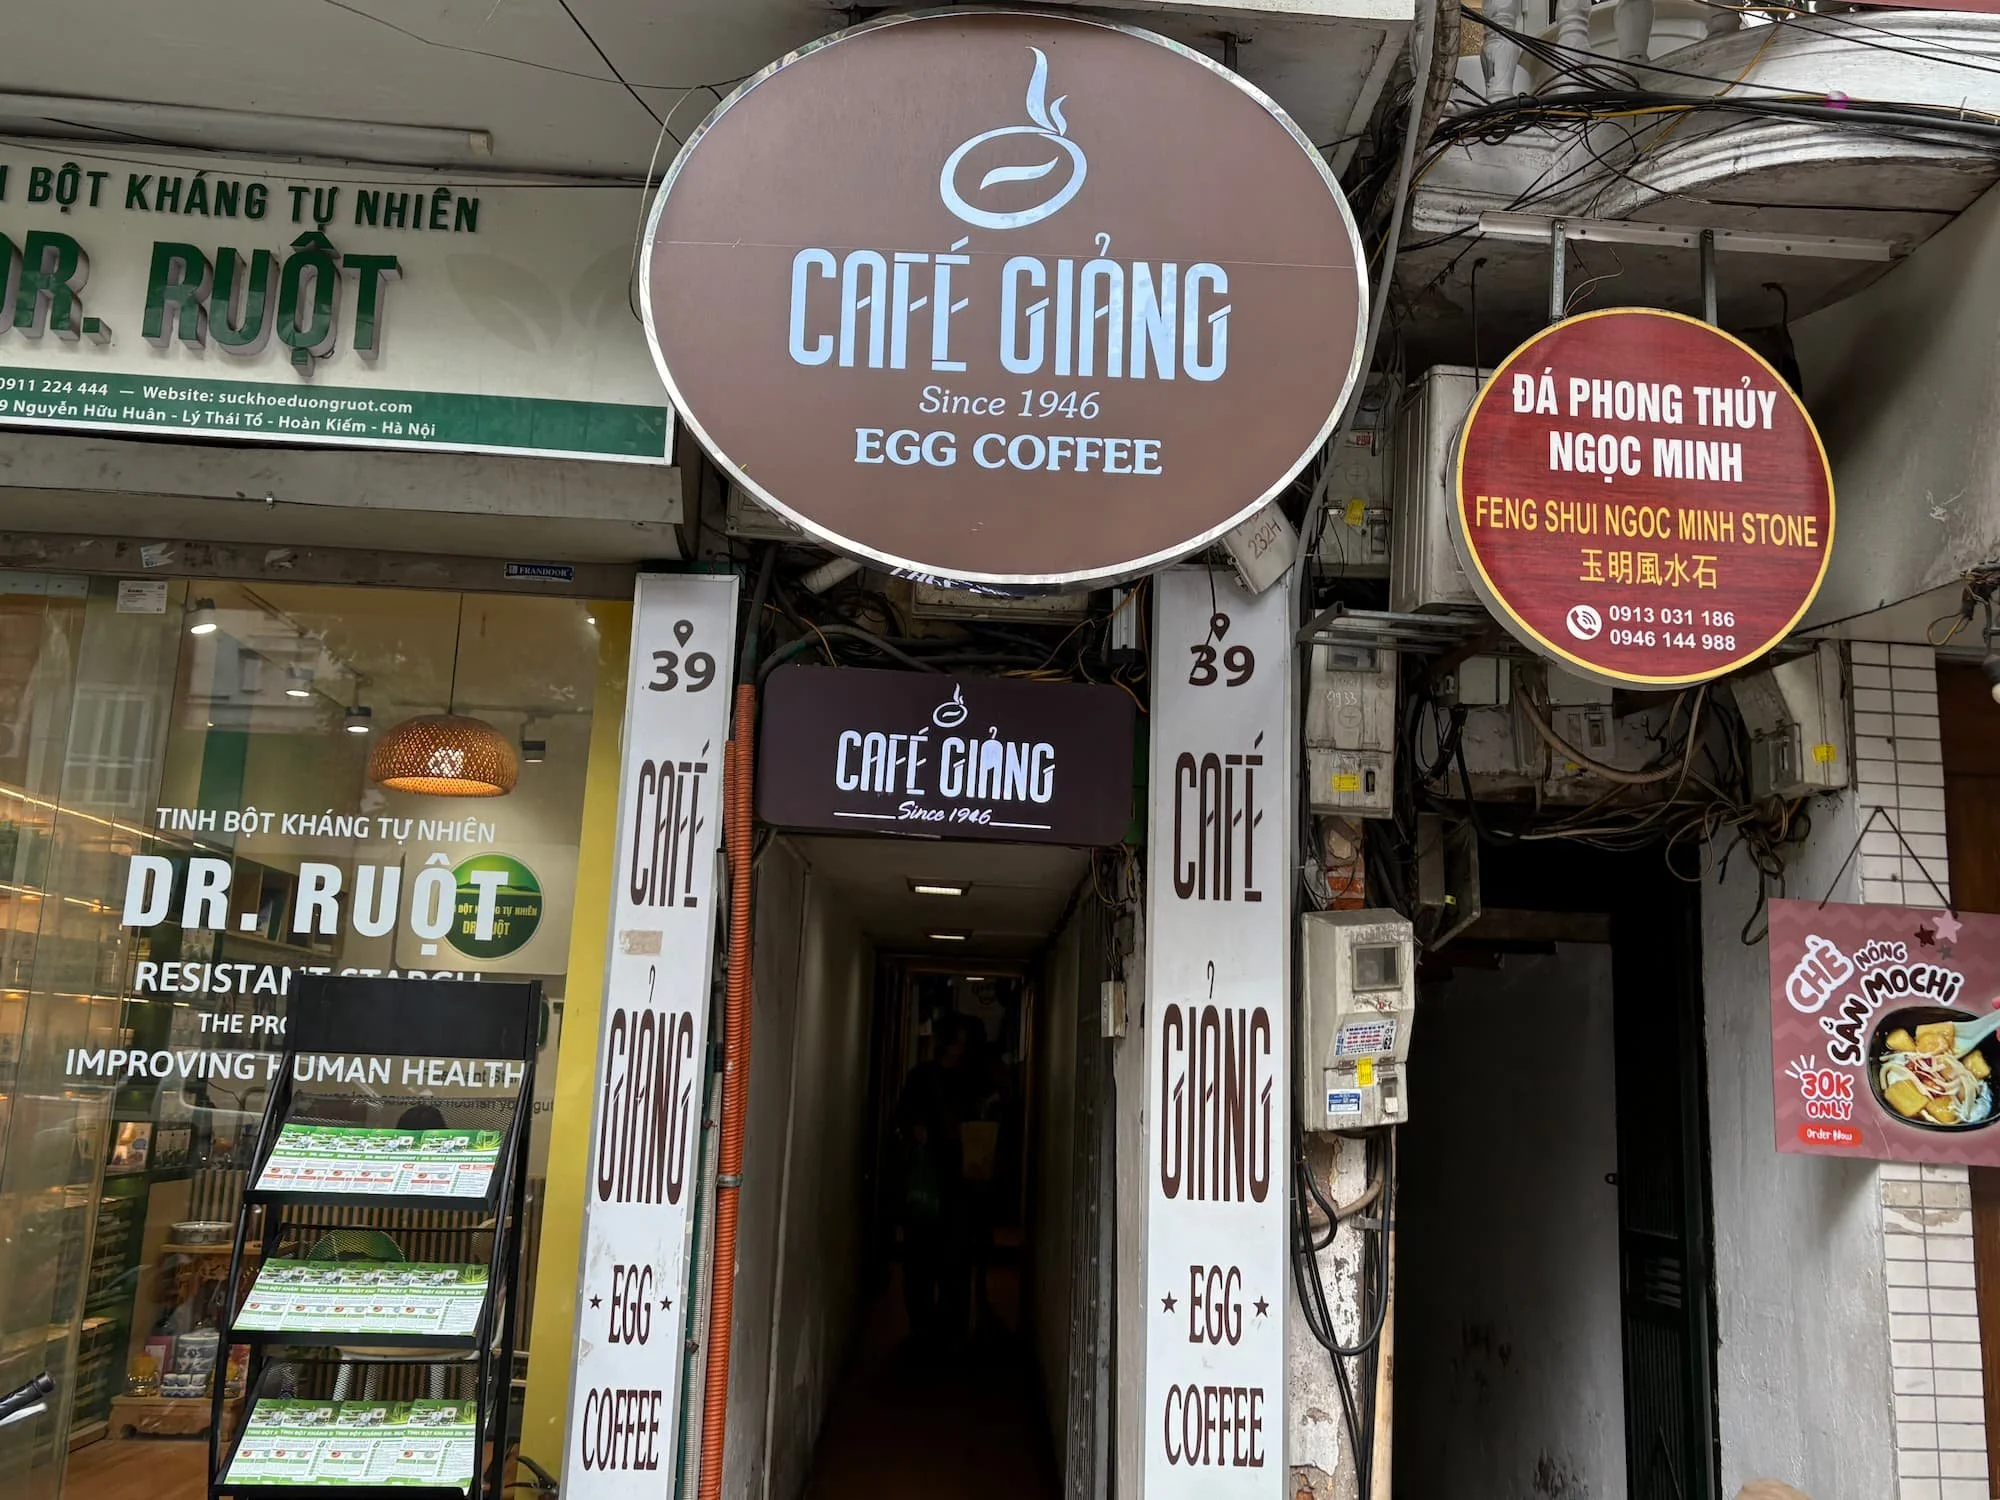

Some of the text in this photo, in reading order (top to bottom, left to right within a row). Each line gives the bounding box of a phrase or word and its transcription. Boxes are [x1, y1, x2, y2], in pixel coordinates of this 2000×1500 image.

[28, 162, 108, 212] BỘT
[125, 170, 268, 219] KHÁNG
[288, 186, 340, 231] TỰ
[355, 187, 478, 232] NHIÊN
[0, 229, 402, 372] R. RUỘT
[789, 232, 1231, 381] CAFÉ GIẢNG
[13, 400, 78, 418] Nguyễn
[84, 404, 118, 418] Hữu
[122, 407, 166, 421] Huân
[182, 410, 200, 426] Lý
[205, 412, 239, 425] Thái
[244, 412, 263, 426] Tổ
[278, 416, 321, 430] Hoàn
[326, 417, 366, 432] Kiếm
[382, 421, 403, 435] Hà
[408, 422, 436, 439] Nội
[41, 380, 73, 394] 224
[77, 383, 108, 396] 444
[143, 386, 214, 402] Website:
[219, 392, 413, 414] suckhoeduongruot.com
[919, 385, 1100, 420] Since 1946
[1513, 367, 1777, 430] ĐÁ PHONG THỦY
[854, 428, 1162, 475] EGG COFFEE
[1549, 431, 1743, 483] NGỌC MINH
[1475, 495, 1818, 548] FENG SHUI NGOC MINH STONE
[1580, 548, 1718, 589] 玉明風水石
[1609, 605, 1735, 628] 0913 031 186
[1609, 629, 1736, 651] 0946 144 988
[648, 650, 716, 692] 39
[1188, 645, 1255, 687] 39
[835, 726, 1056, 803] CAFÉ GIẢNG
[156, 807, 496, 845] TINH BỘT KHÁNG TỰ NHIÊN
[630, 738, 710, 908] CAFÉ
[897, 800, 993, 825] Since 1946
[1174, 730, 1263, 902] CAFÉ
[121, 851, 510, 956] DR. RUỘT
[198, 1013, 243, 1034] THE
[65, 1048, 256, 1081] IMPROVING
[401, 1058, 525, 1089] HEALTH
[598, 964, 694, 1204] GIẢNG
[1160, 960, 1273, 1203] GIẢNG
[1802, 1070, 1853, 1099] 30K
[1806, 1128, 1832, 1140] Order
[1807, 1101, 1852, 1120] ONLY
[608, 1264, 653, 1345] EGG
[1189, 1264, 1242, 1346] EGG
[582, 1387, 662, 1471] COFFEE
[1164, 1384, 1265, 1468] COFFEE
